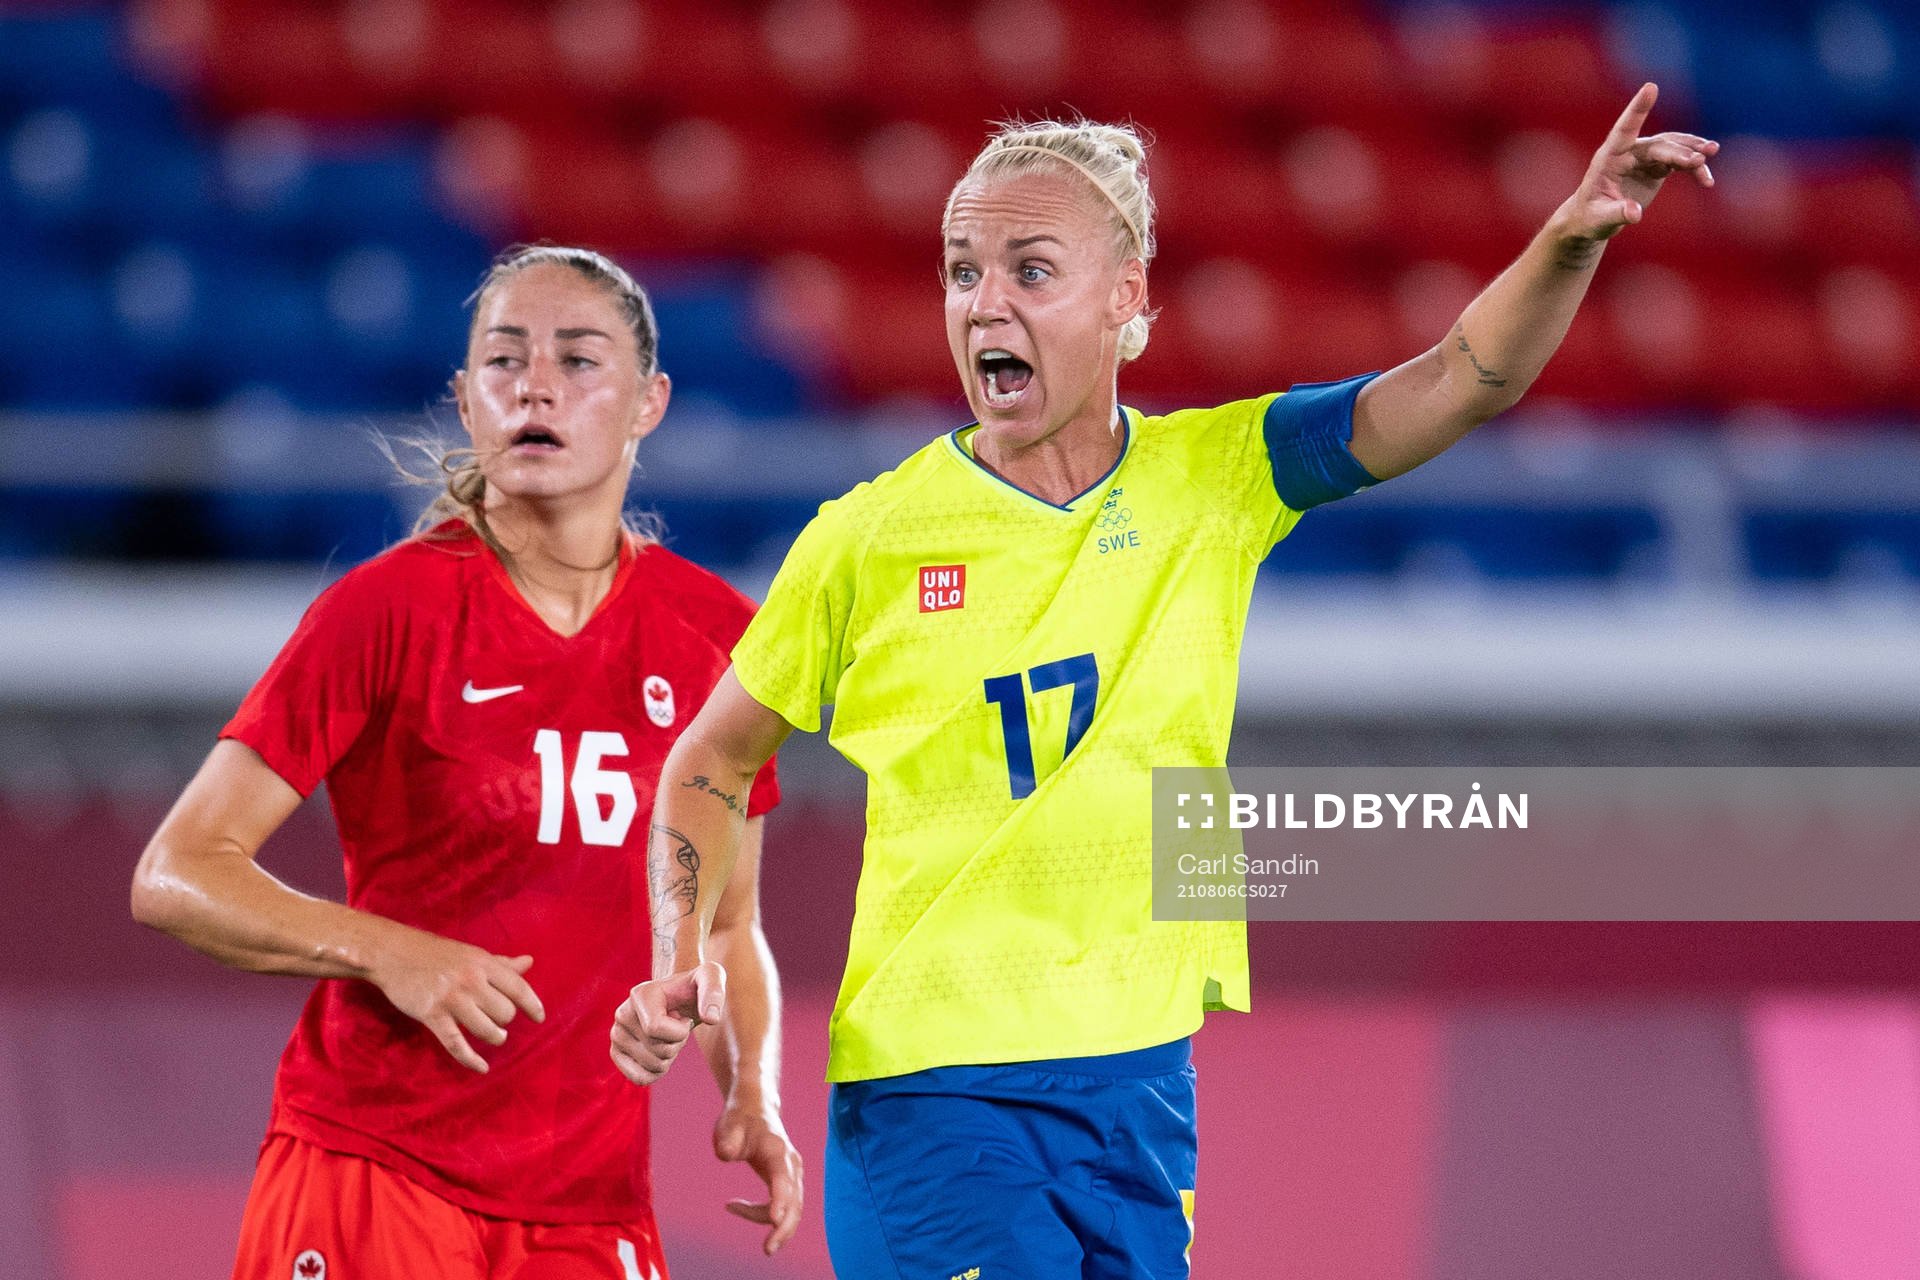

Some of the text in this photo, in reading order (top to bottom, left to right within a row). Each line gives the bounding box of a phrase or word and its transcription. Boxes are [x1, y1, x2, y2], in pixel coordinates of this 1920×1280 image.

[1098, 530, 1141, 554] SWE
[924, 571, 959, 588] UNI
[923, 589, 961, 610] QLO
[983, 652, 1100, 800] 17
[533, 728, 638, 847] 16
